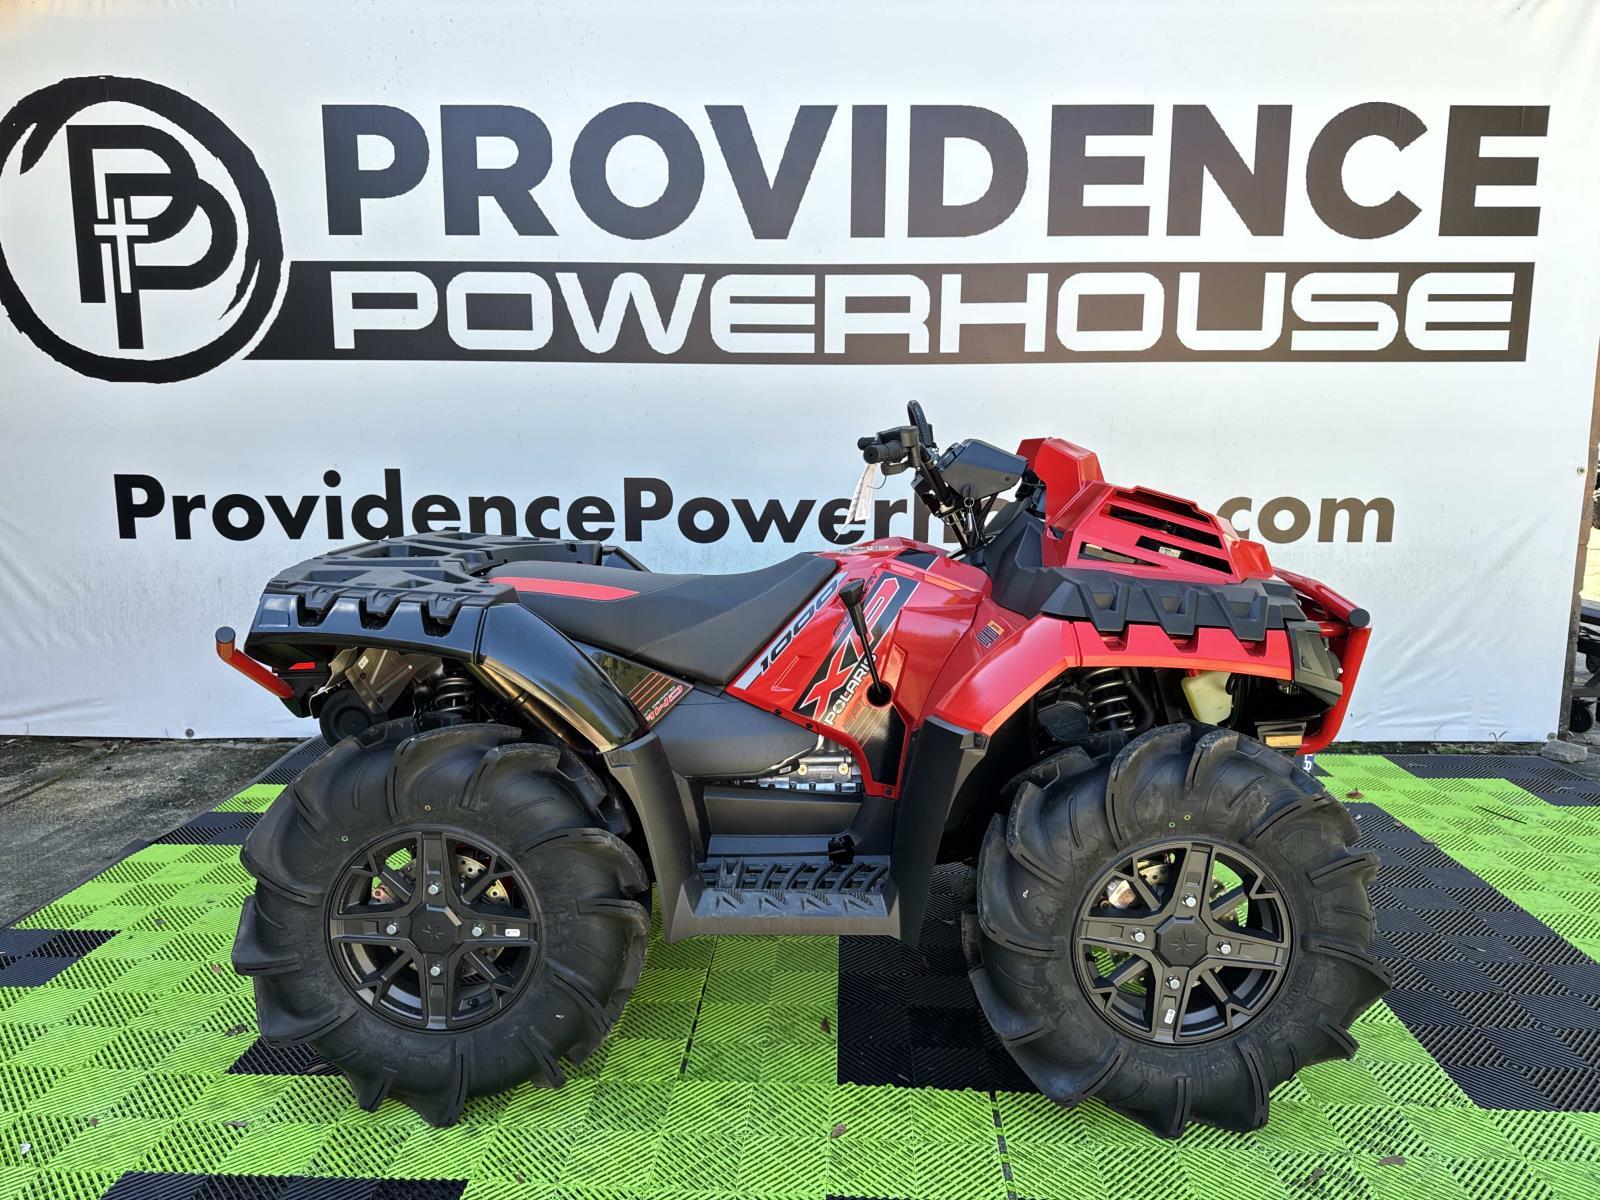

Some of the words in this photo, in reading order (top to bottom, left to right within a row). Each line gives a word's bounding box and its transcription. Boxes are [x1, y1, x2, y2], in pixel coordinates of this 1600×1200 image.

[321, 101, 1550, 240] PROVIDENCE
[330, 270, 1515, 355] POWERHOUSE
[113, 468, 1394, 543] ProvidencePowerhcom
[759, 578, 839, 673] 1000
[798, 576, 900, 721] XP
[824, 653, 877, 726] POLARIS
